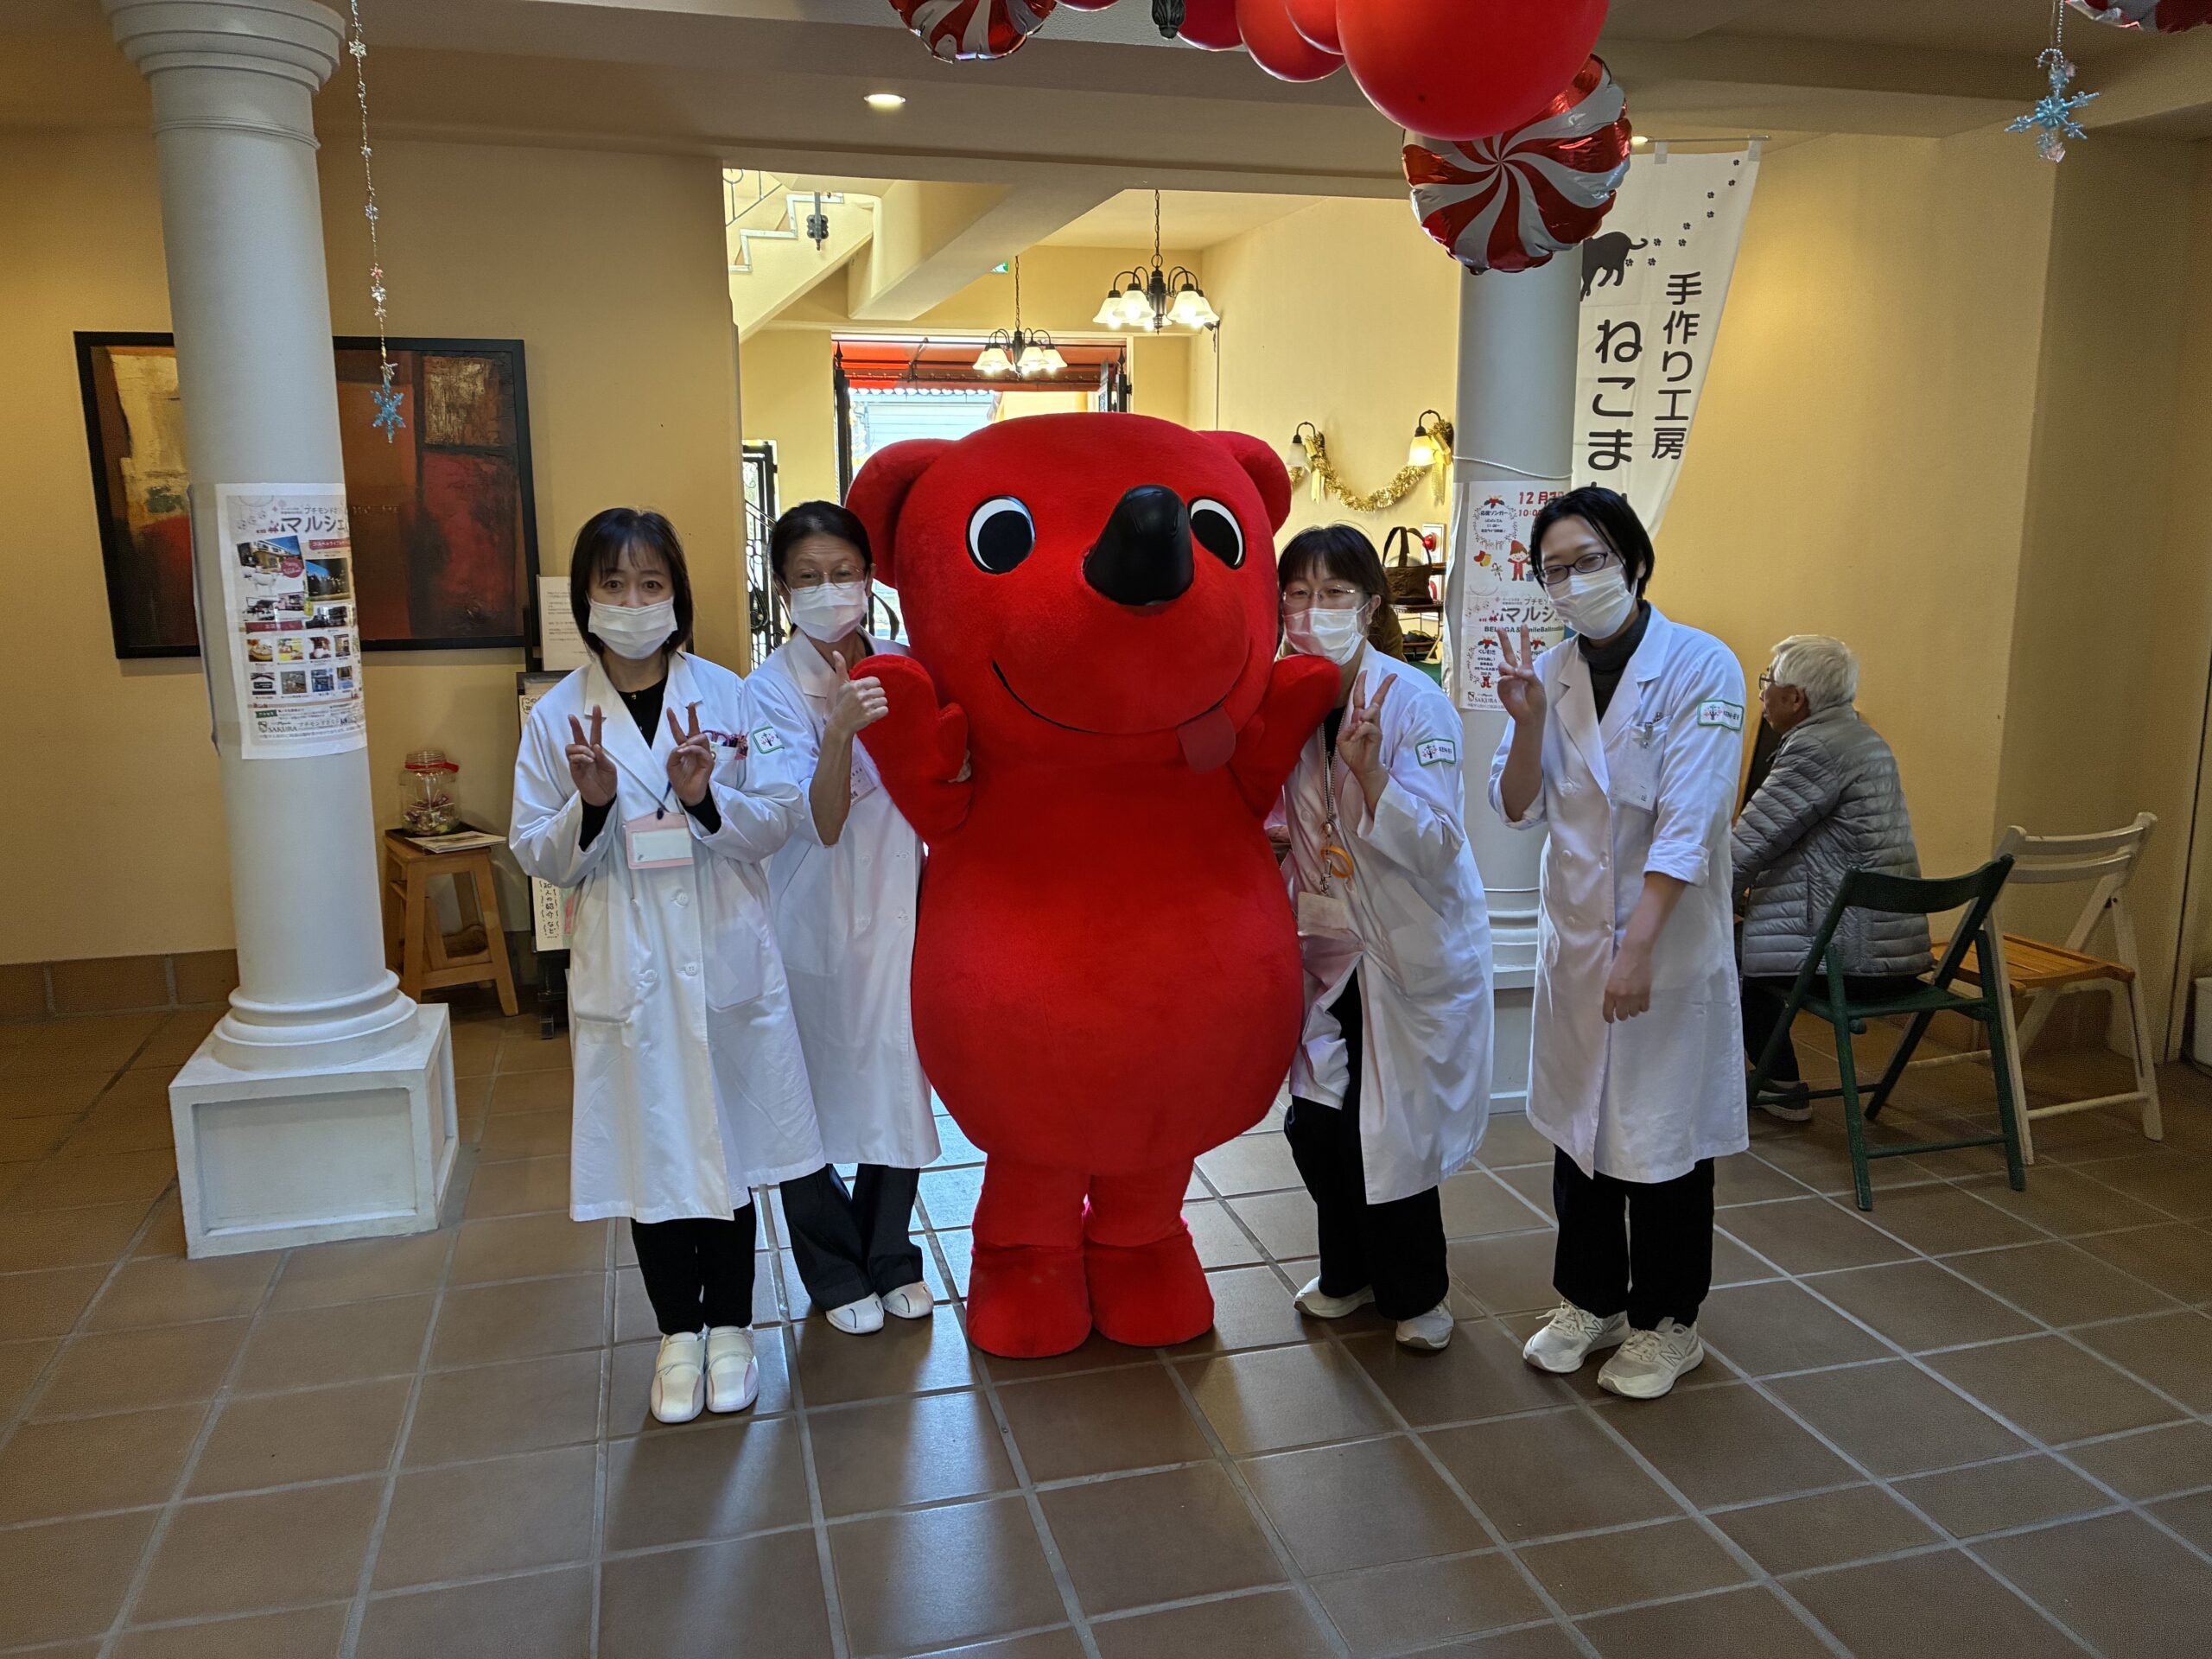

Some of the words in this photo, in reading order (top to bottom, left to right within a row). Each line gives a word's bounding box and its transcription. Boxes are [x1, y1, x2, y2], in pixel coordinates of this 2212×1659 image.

[1587, 318, 1643, 501] ねこま
[1651, 271, 1702, 460] 手作り工房
[281, 515, 345, 533] マルシェ
[1501, 606, 1560, 623] マルシ
